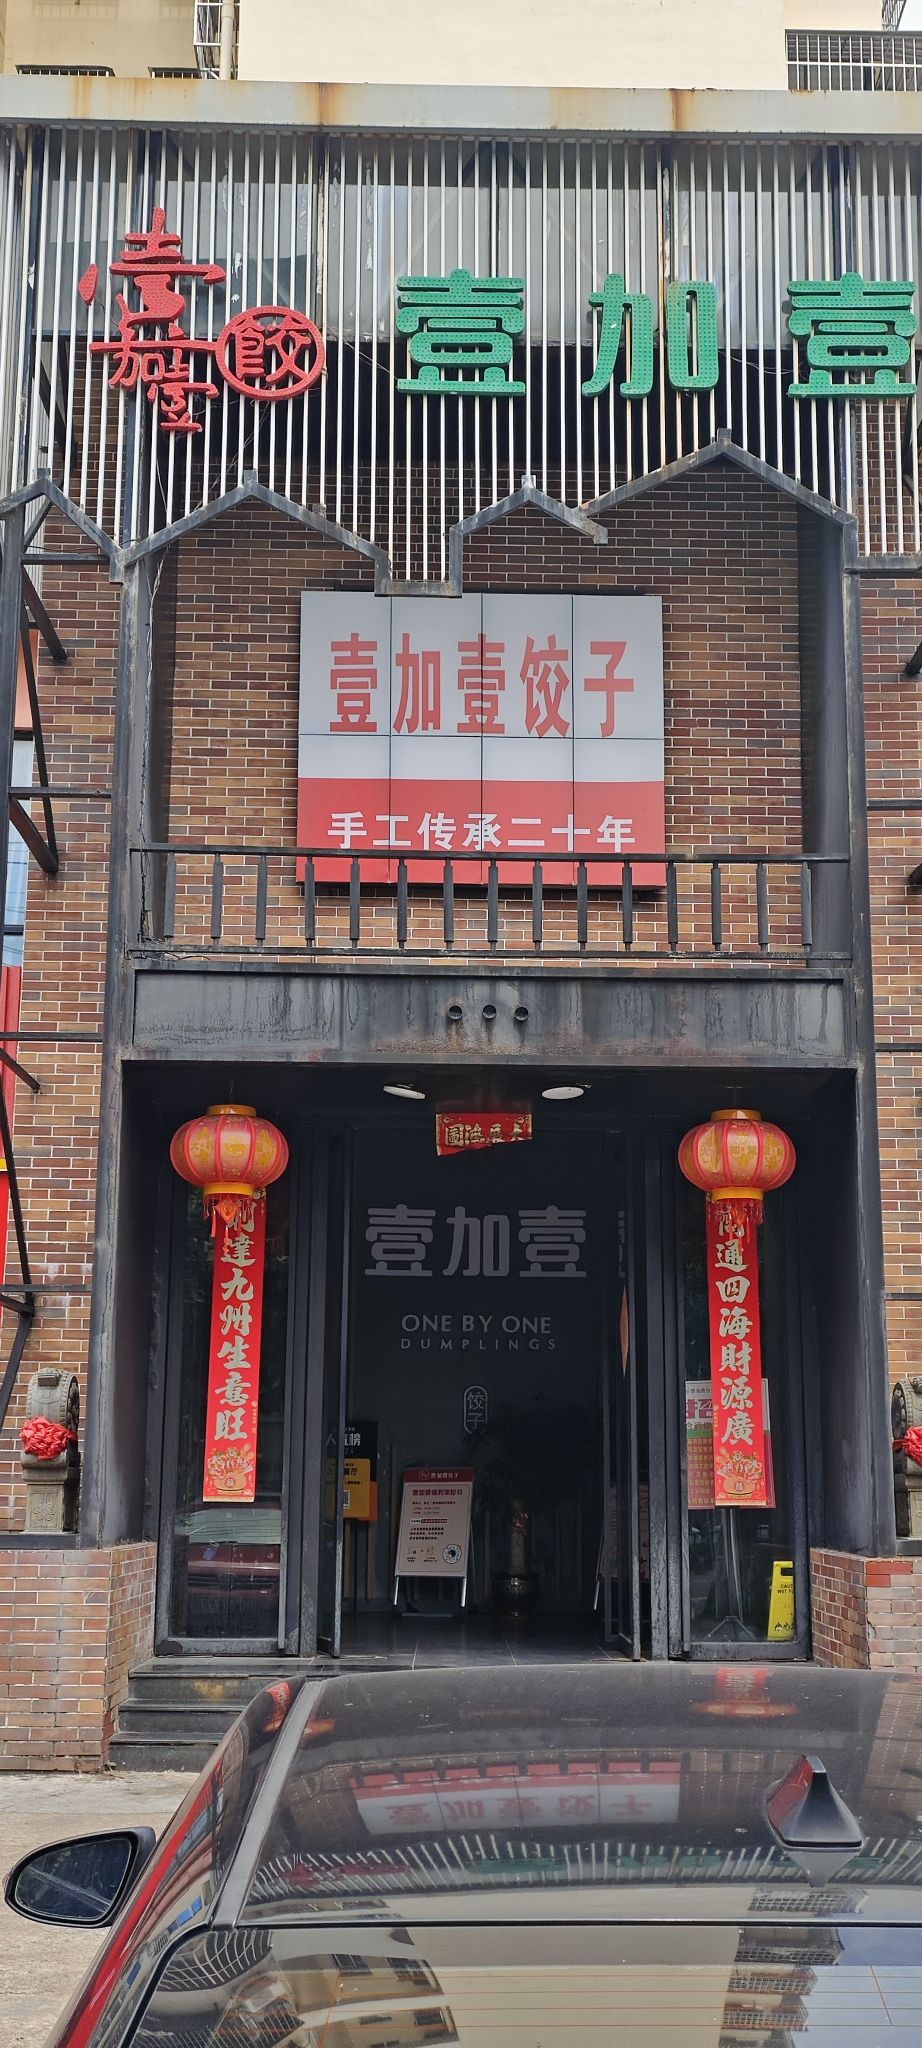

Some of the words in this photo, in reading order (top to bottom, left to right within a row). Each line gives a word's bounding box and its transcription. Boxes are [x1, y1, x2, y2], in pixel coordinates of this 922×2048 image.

[396, 268, 917, 399] 壹加壹
[329, 633, 635, 738] 壹加壹饺子
[327, 811, 636, 853] 手工传承二十年
[364, 1203, 587, 1278] 壹加壹
[400, 1338, 556, 1351] DUMPLINGS
[401, 1314, 452, 1333] ONE
[462, 1315, 494, 1333] BY
[501, 1315, 552, 1334] ONE
[466, 1390, 487, 1432] 饺子
